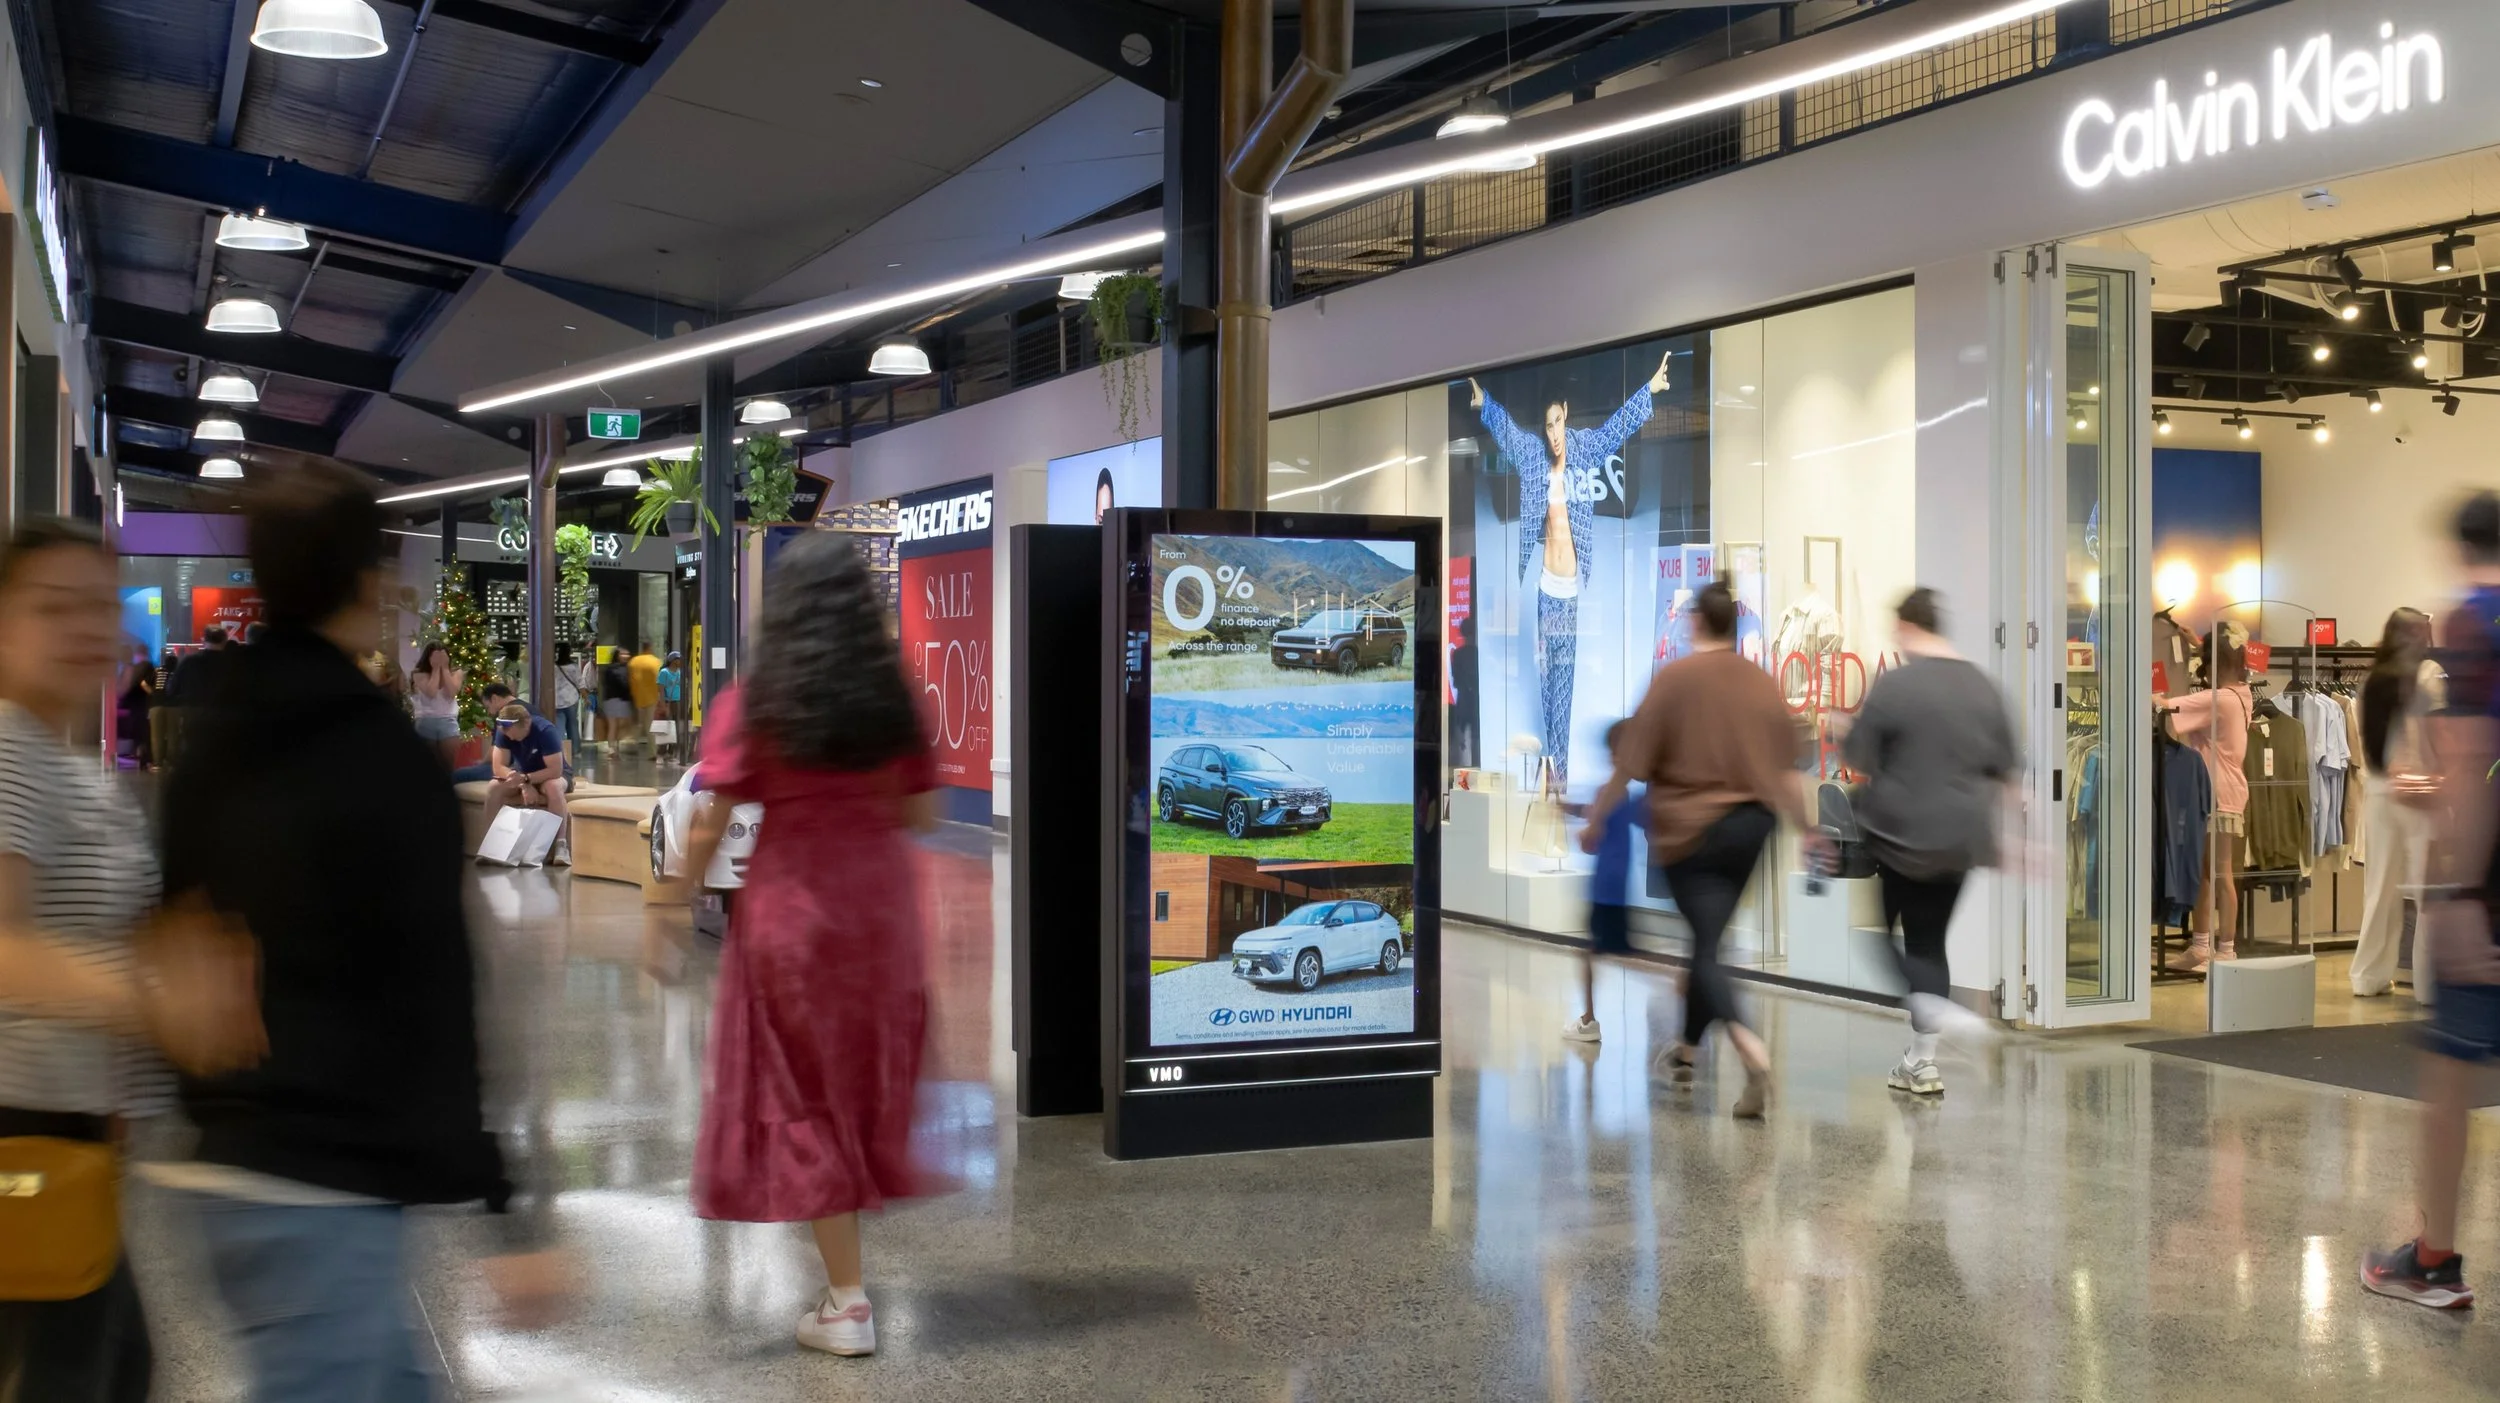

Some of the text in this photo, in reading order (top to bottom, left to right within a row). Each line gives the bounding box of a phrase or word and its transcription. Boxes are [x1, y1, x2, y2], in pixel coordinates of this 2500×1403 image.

[2061, 21, 2445, 189] Calvin Klein
[896, 490, 993, 543] SKECHERS
[1160, 550, 1186, 559] From
[926, 572, 974, 620] SALE
[1163, 565, 1254, 632] 0%
[1221, 603, 1260, 613] finance
[1220, 618, 1235, 626] no
[1168, 641, 1258, 653] Across the range
[1327, 724, 1373, 740] Simply
[1327, 742, 1405, 755] Undeniable
[1327, 760, 1366, 773] Value
[1239, 1006, 1352, 1024] GWD HYUNDAI
[1150, 1066, 1183, 1082] VMO
